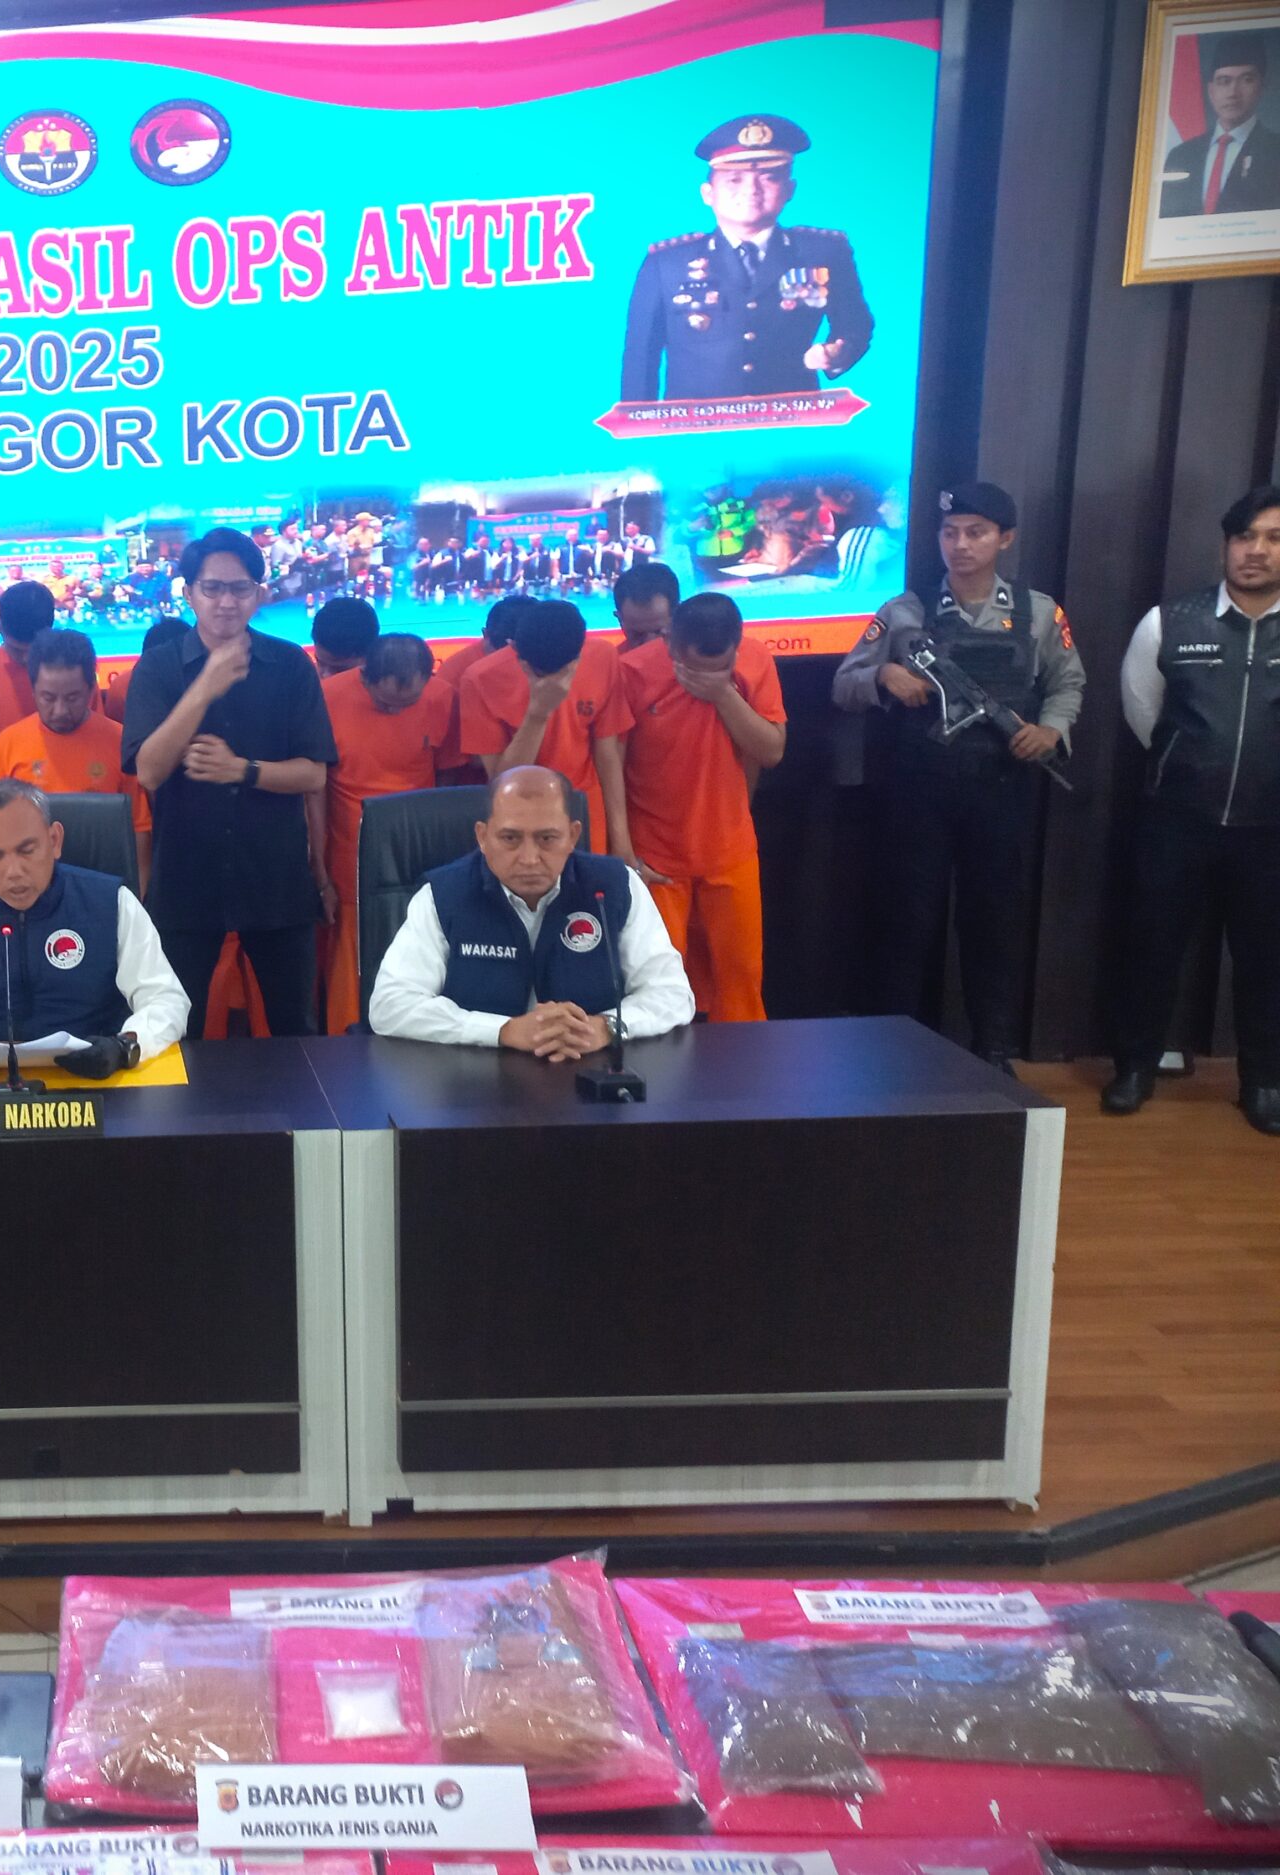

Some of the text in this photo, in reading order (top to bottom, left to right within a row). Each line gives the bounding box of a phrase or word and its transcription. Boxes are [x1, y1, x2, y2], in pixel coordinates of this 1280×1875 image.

[174, 211, 327, 308] OPS
[345, 195, 593, 296] ANTIK
[184, 390, 410, 464] KOTA
[1177, 643, 1220, 654] HARRY
[460, 943, 518, 959] WAKASAT
[5, 1101, 96, 1130] NARKOBA
[835, 1596, 996, 1612] BARANG BUKTI
[247, 1784, 425, 1808] BARANG BUKTI
[240, 1820, 438, 1838] NARKOTIKA JENIS GANJA
[99, 1837, 167, 1855] BUKTI
[579, 1855, 766, 1875] BARANG BUKTI
